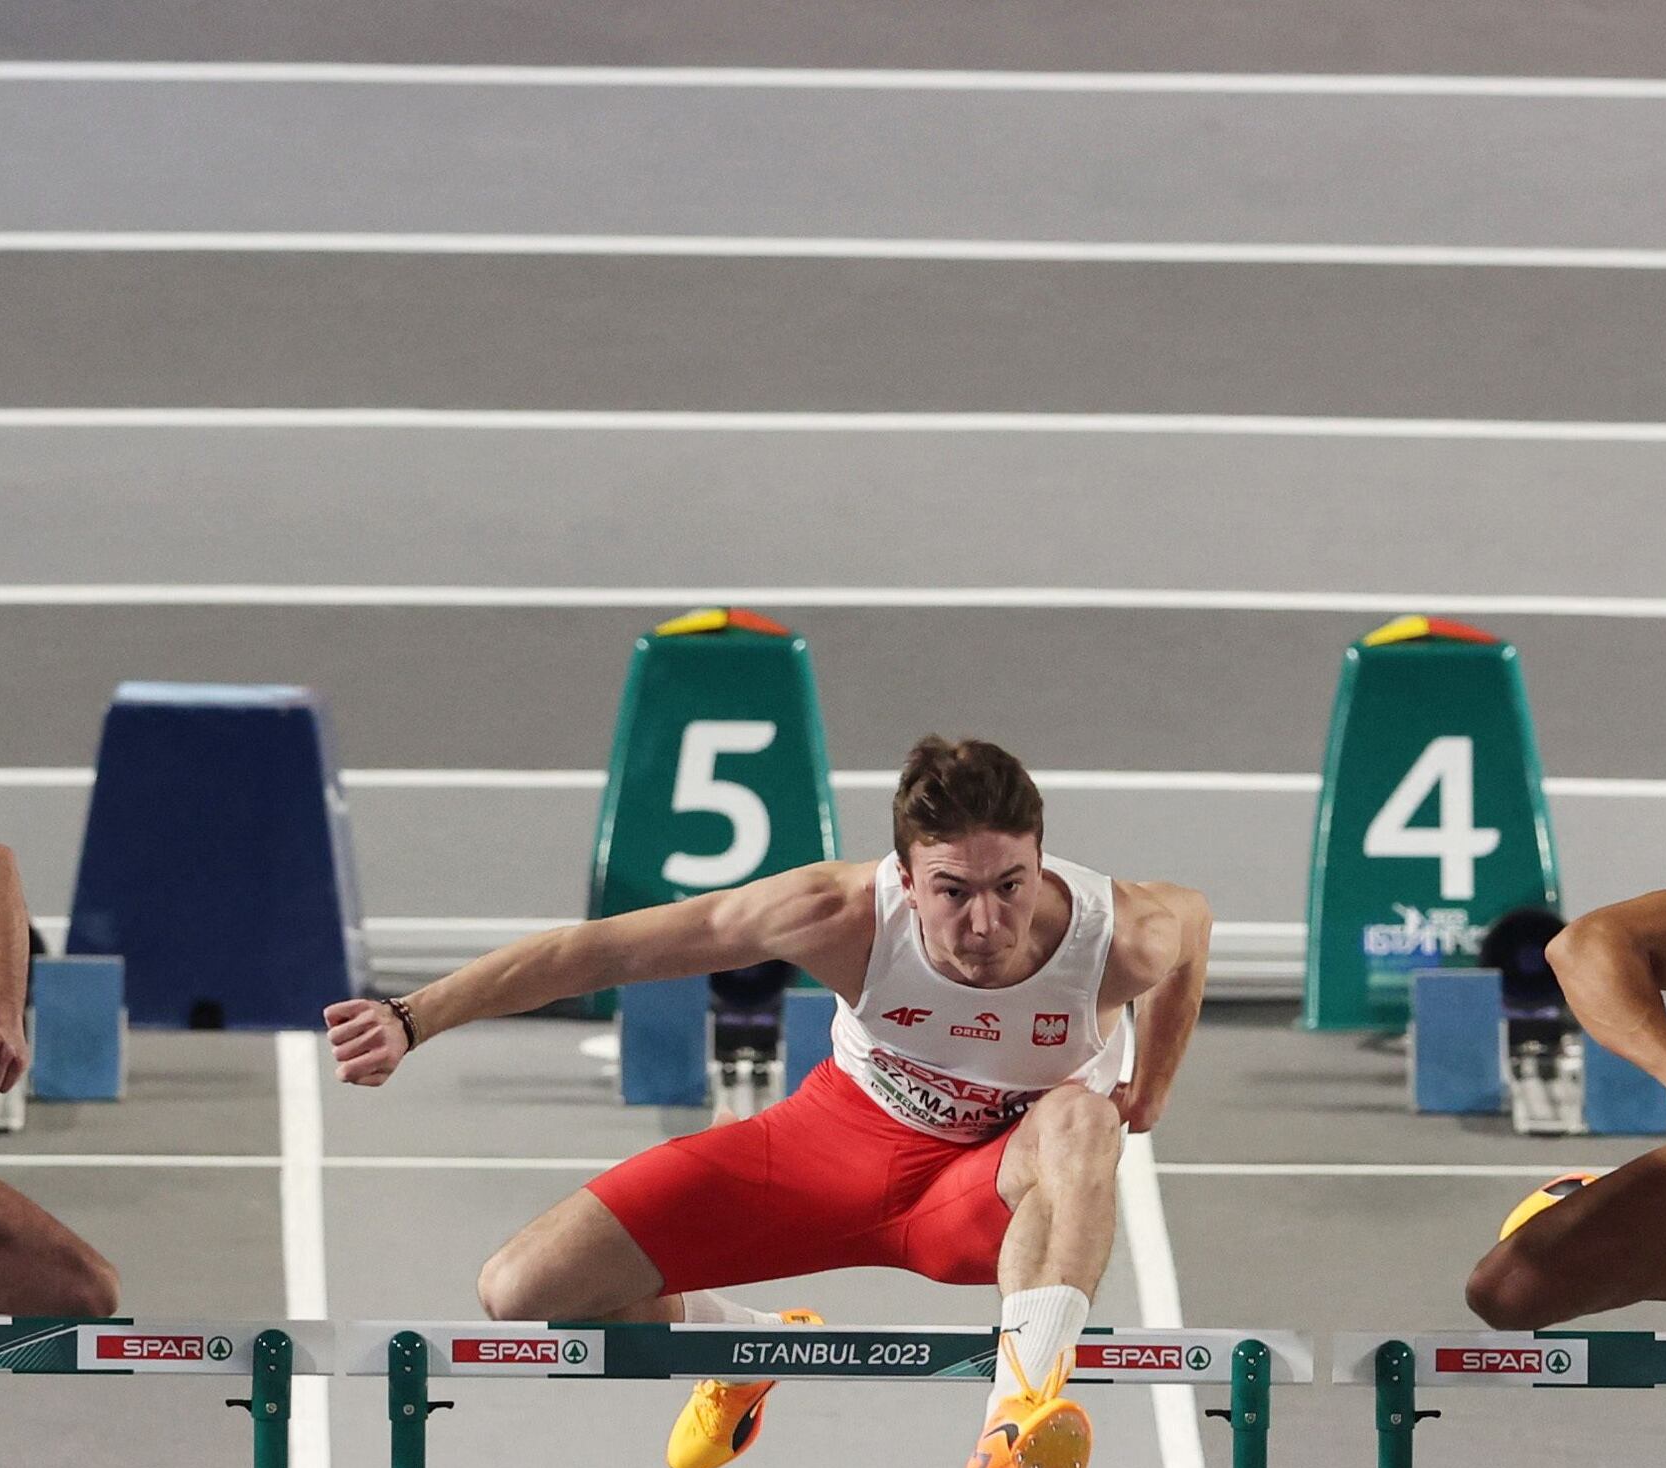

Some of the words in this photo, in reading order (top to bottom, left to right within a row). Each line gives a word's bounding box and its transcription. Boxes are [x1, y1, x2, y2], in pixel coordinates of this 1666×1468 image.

[661, 719, 778, 889] 5
[1362, 735, 1501, 901] 4
[952, 1026, 999, 1041] ORLEN
[122, 1339, 202, 1357] SPAR
[478, 1342, 557, 1361] SPAR
[732, 1342, 862, 1365] ISTANBUL
[867, 1344, 931, 1366] 2023
[1101, 1348, 1180, 1367] SPAR
[1462, 1351, 1541, 1371] SPAR
